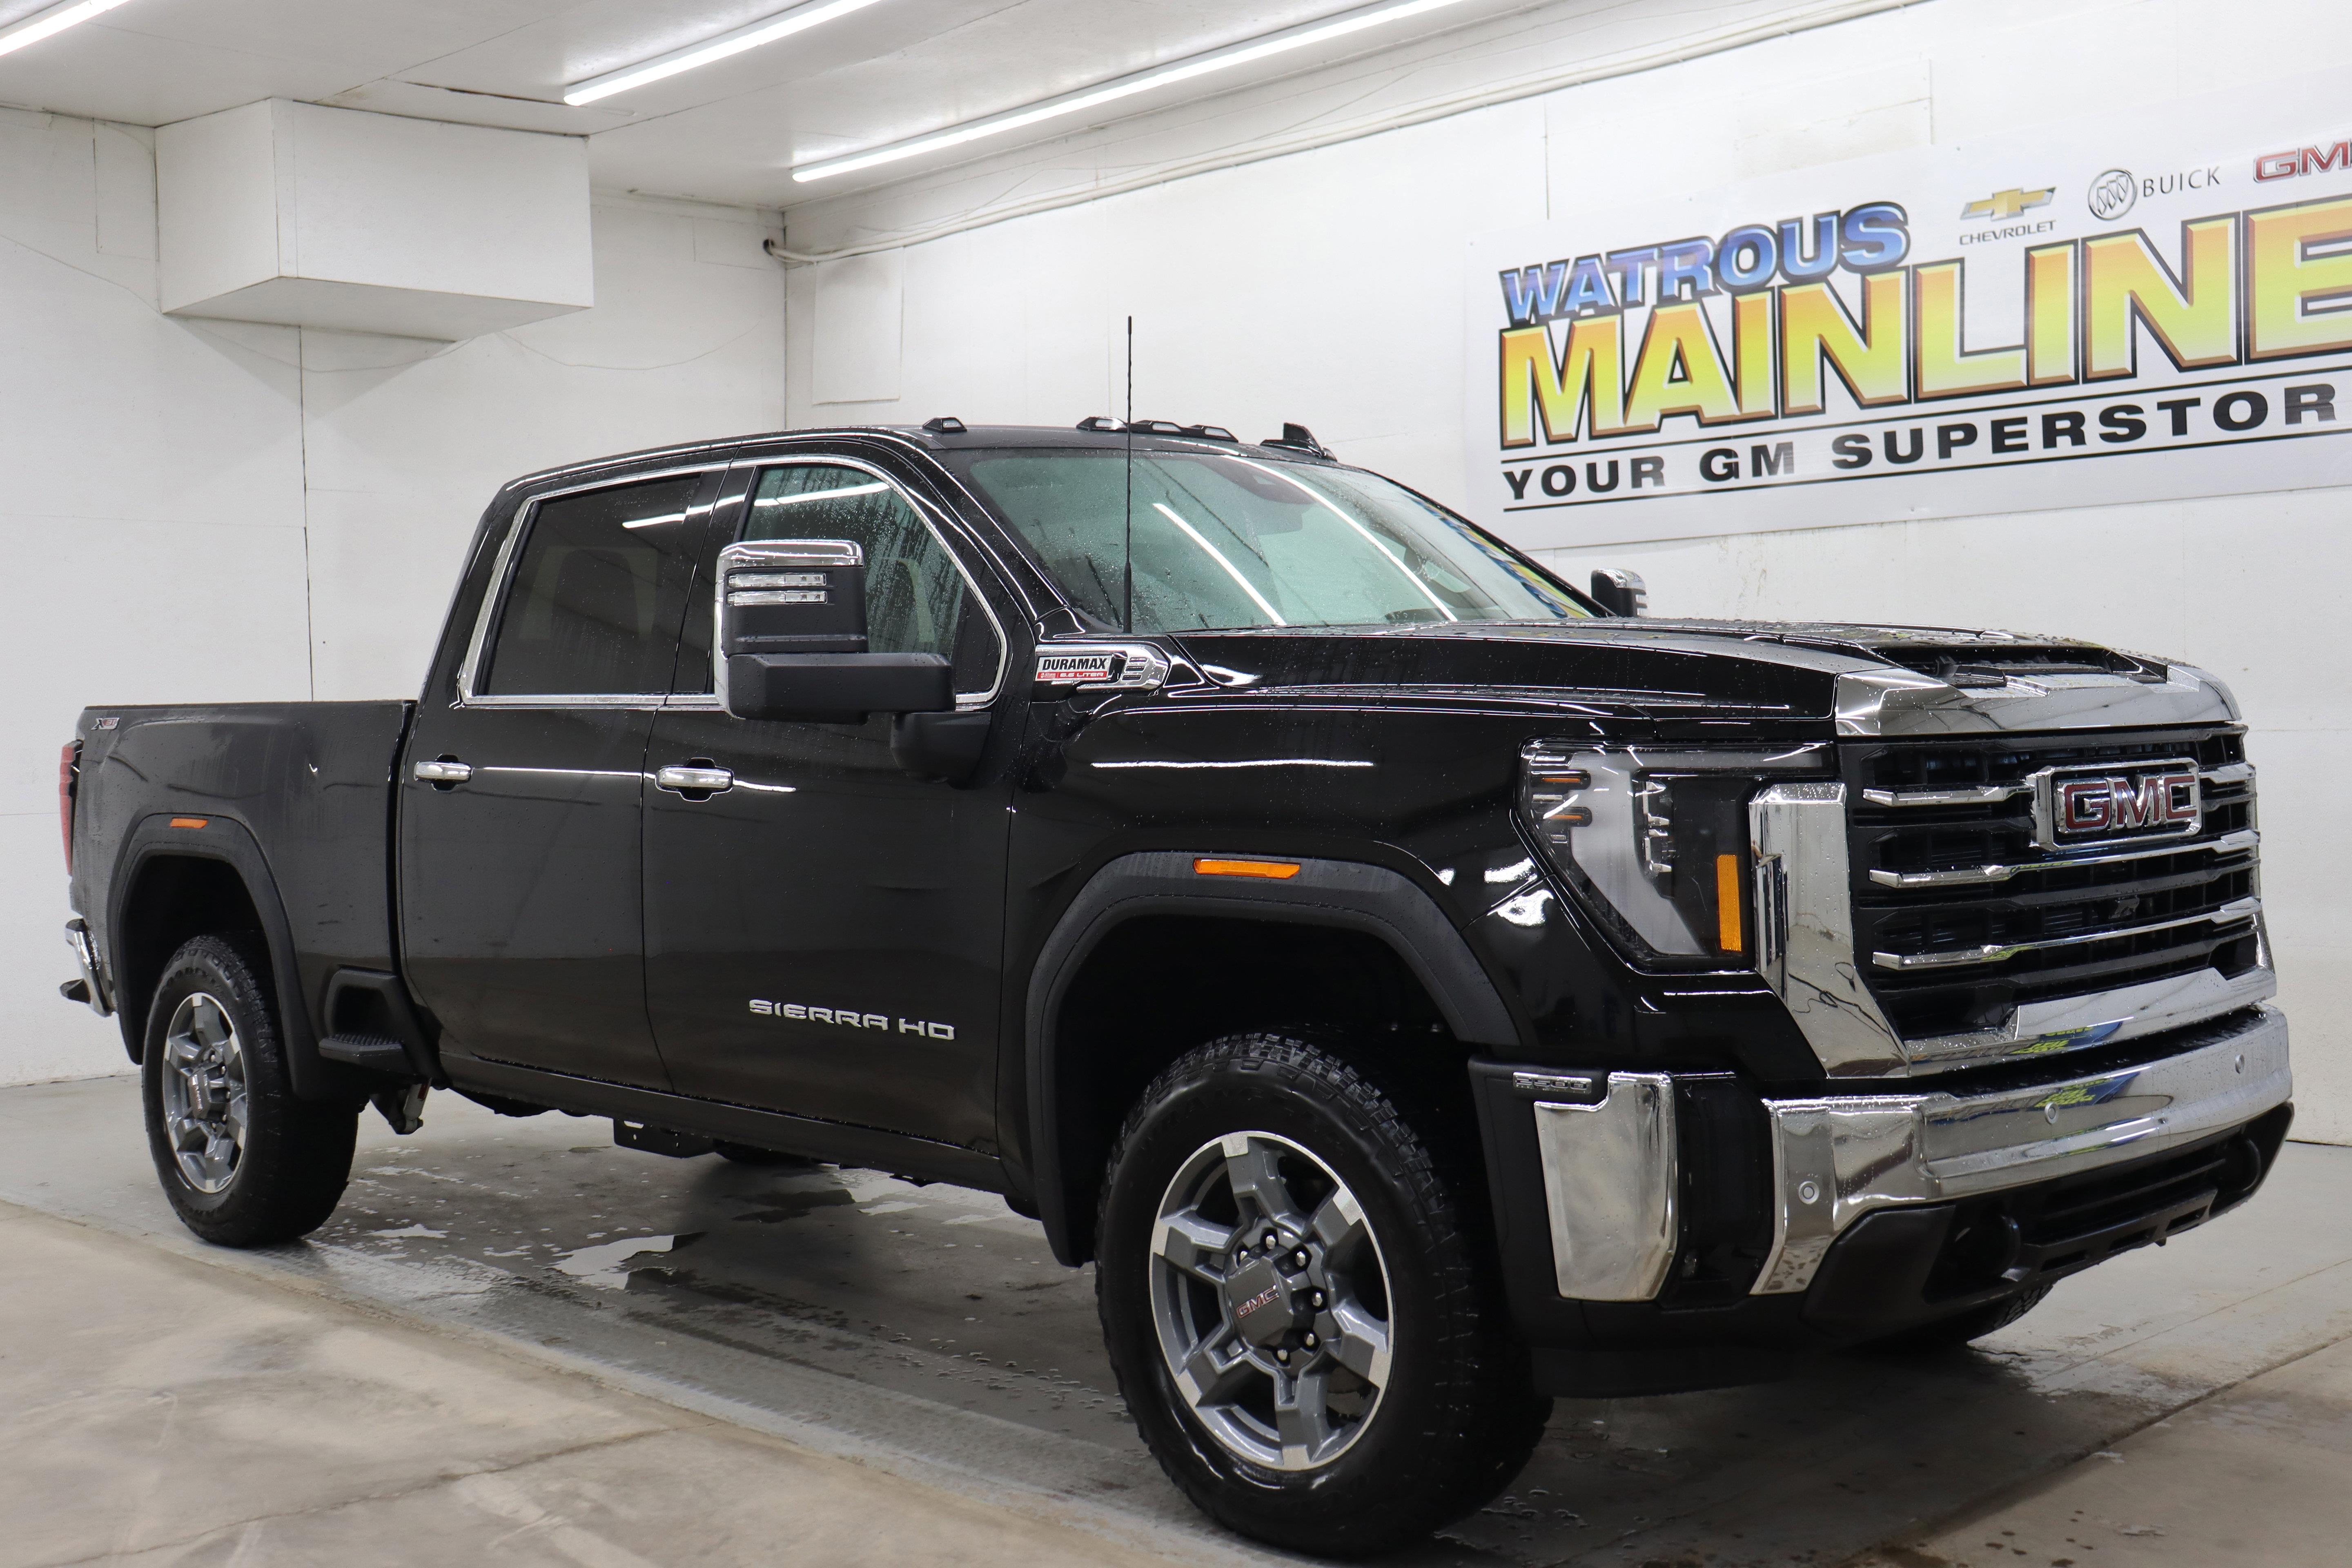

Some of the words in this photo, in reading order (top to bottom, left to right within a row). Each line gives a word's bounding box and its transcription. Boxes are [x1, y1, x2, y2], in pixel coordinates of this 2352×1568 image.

[2253, 137, 2352, 183] GM
[2144, 167, 2221, 197] BUICK
[1959, 220, 2056, 245] CHEVROLET
[1499, 201, 1909, 323] WATROUS
[1499, 194, 2352, 450] MAINLINE
[1503, 455, 1668, 501] YOUR
[1699, 441, 1795, 483] GM
[1042, 658, 1107, 670] DURAMAX
[2055, 774, 2199, 835] GMC
[749, 999, 889, 1031] SIERRA
[898, 1018, 955, 1040] HD
[1236, 1285, 1280, 1319] GMC
